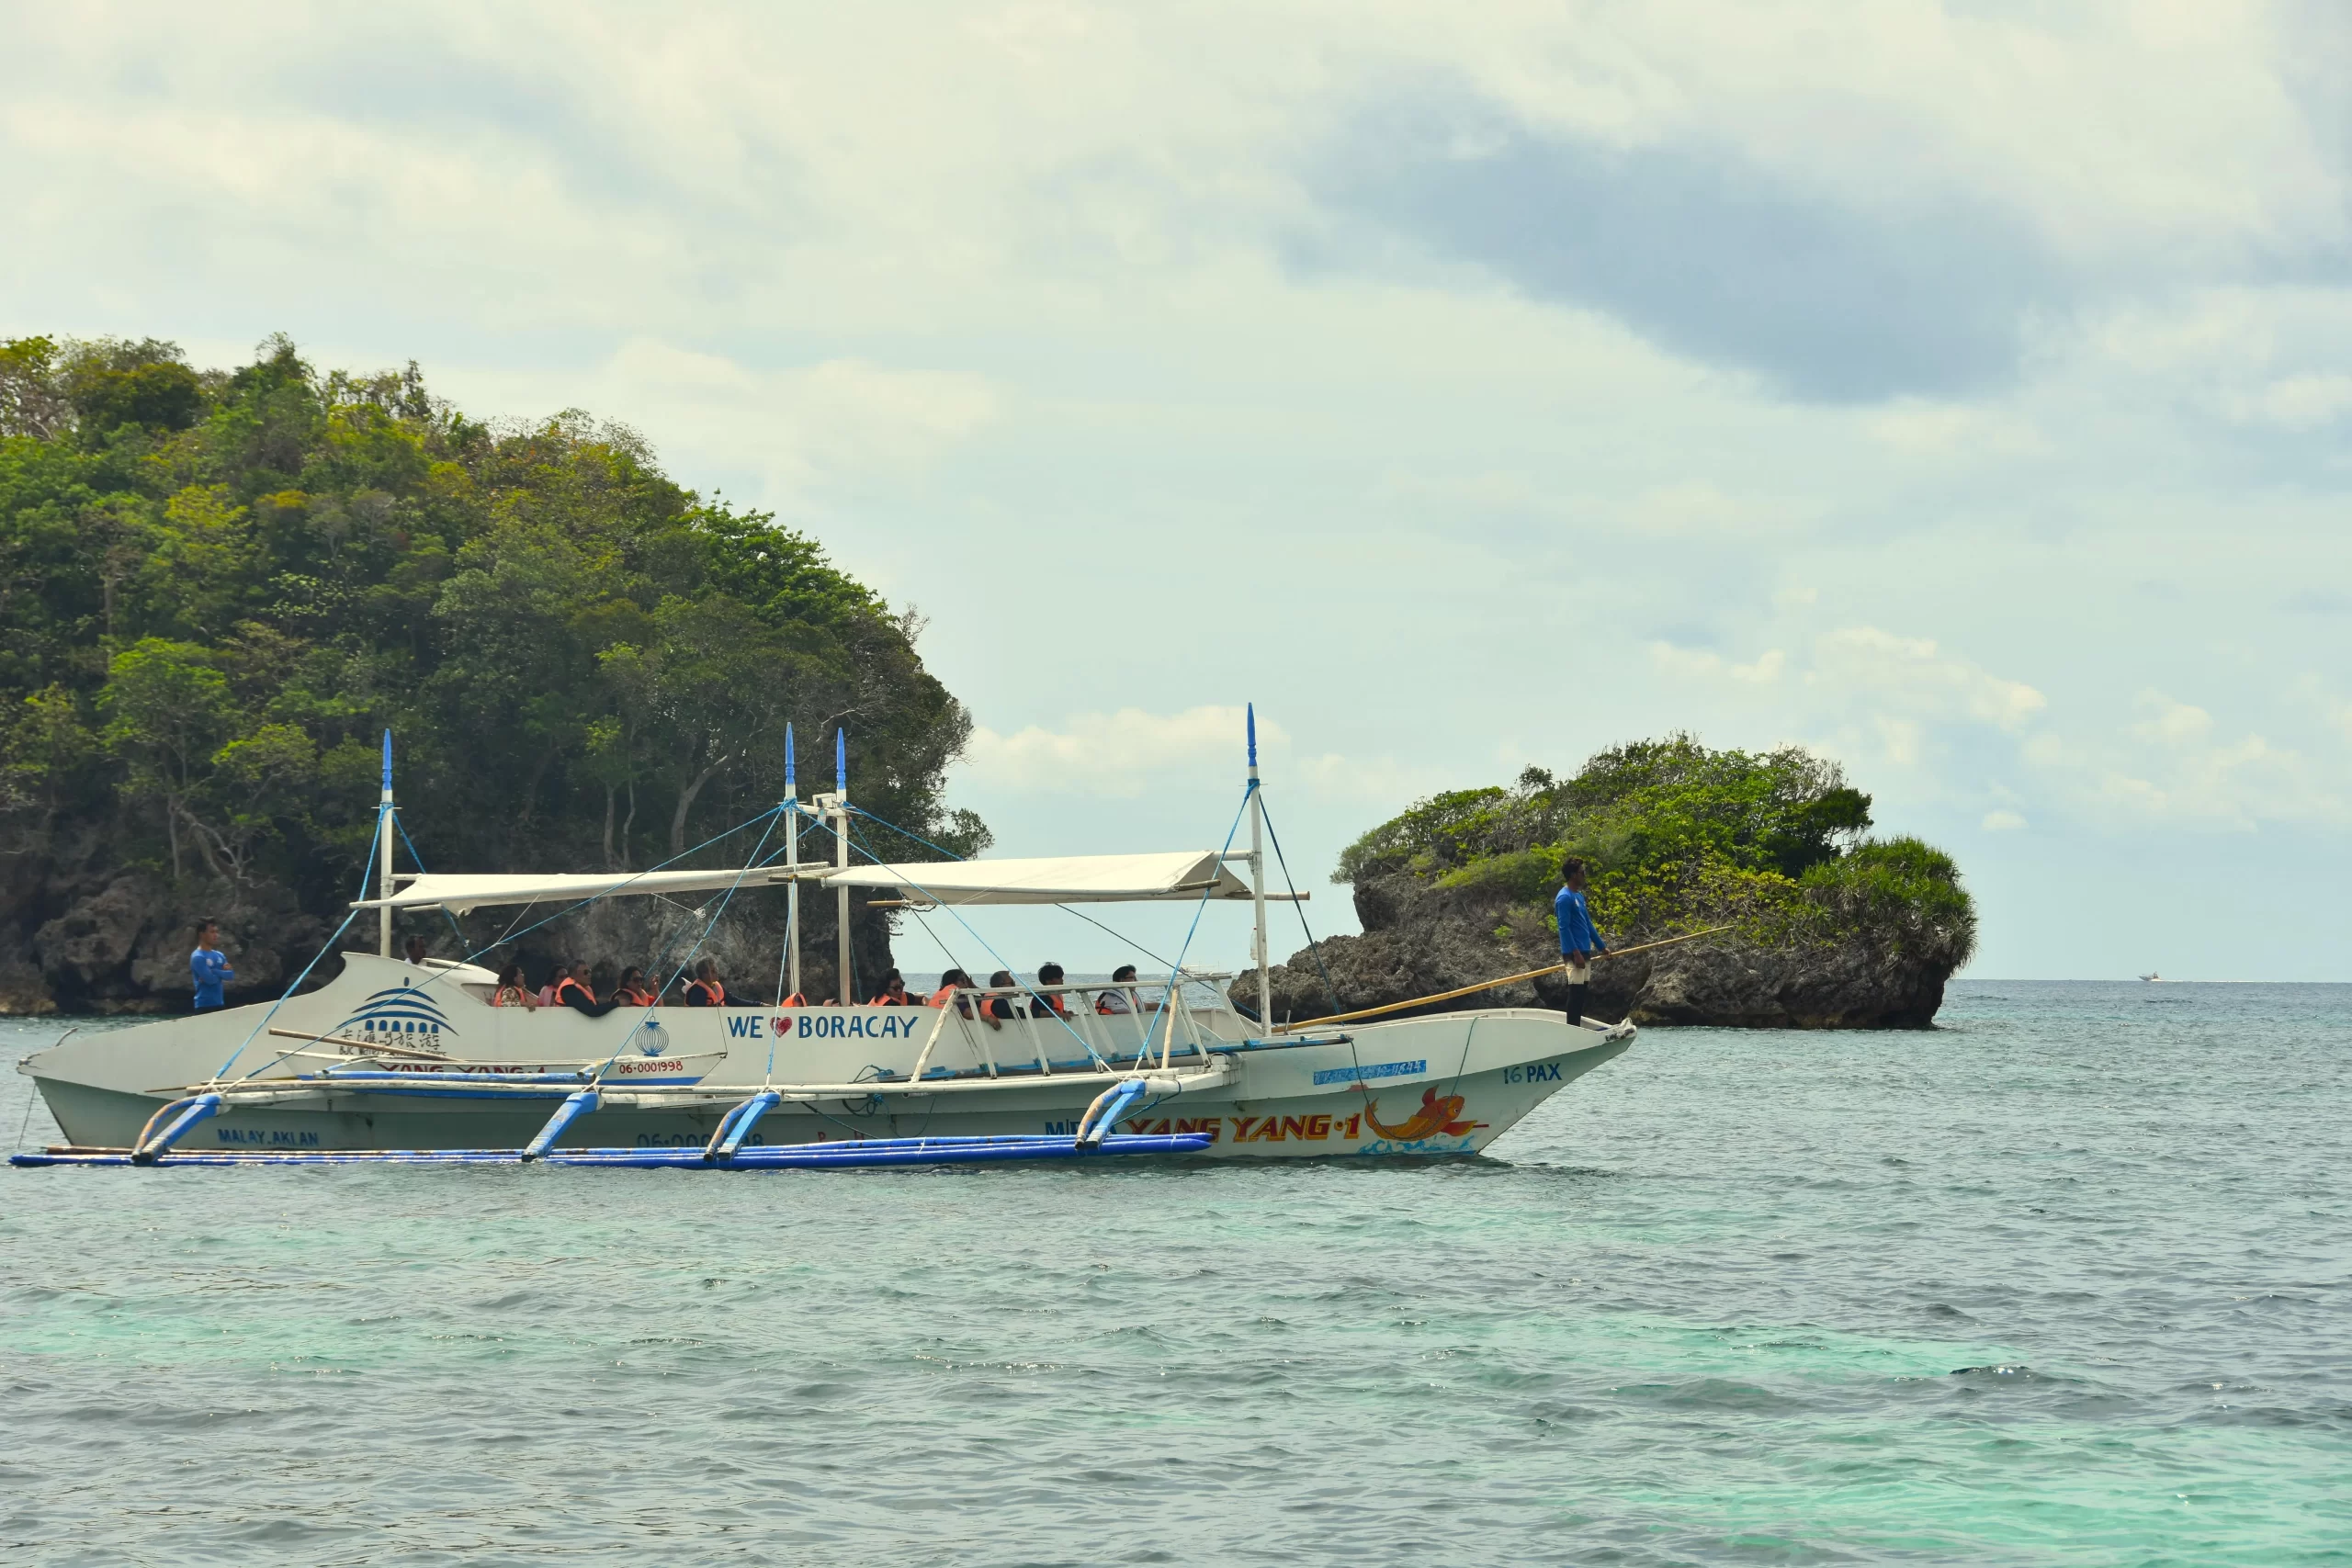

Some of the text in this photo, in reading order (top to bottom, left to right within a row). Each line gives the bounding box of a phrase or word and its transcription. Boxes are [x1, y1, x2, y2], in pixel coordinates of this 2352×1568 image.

[728, 1016, 919, 1038] WE BORACAY
[1504, 1063, 1562, 1084] 16 PAX
[1123, 1118, 1221, 1143] YANG
